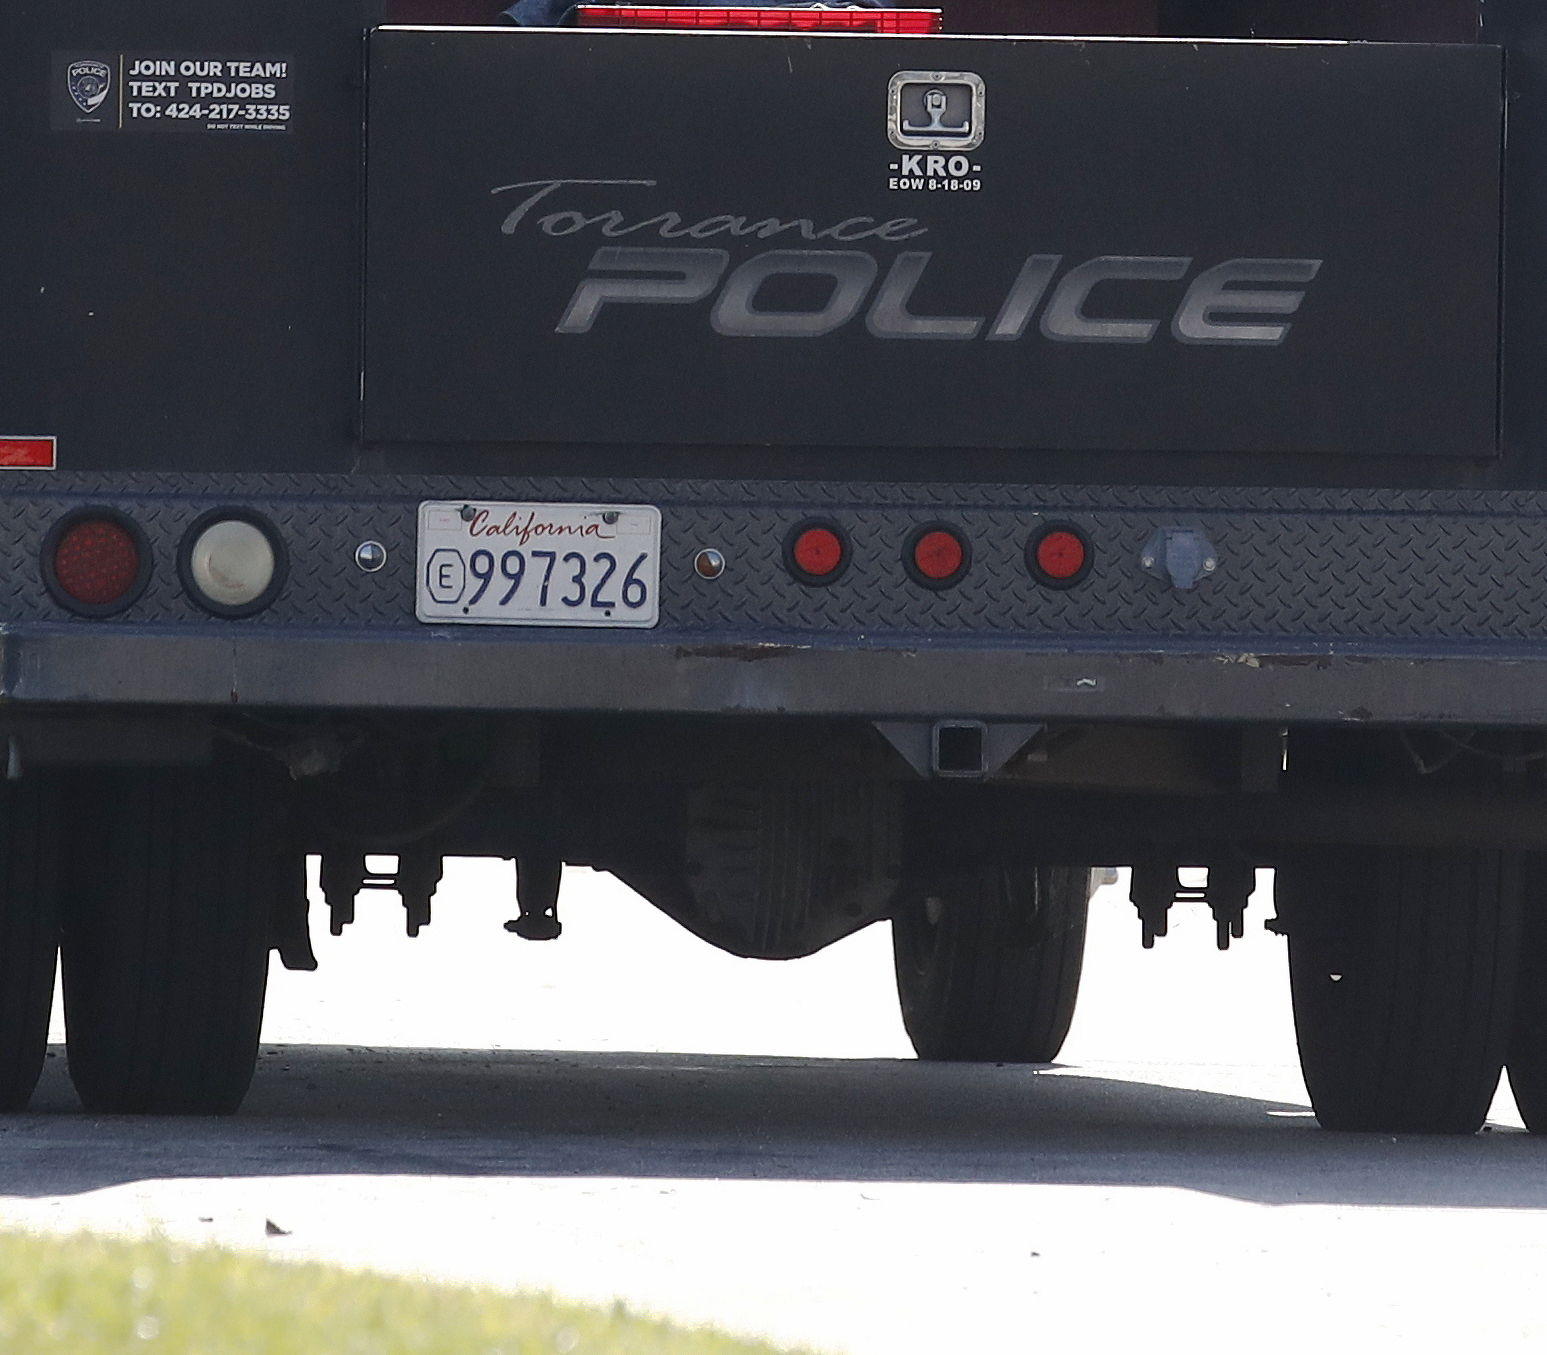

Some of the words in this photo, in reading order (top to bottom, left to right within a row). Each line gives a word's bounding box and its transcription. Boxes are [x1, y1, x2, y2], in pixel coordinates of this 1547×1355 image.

[71, 66, 108, 78] POLICE
[128, 59, 176, 77] JOIN
[179, 60, 223, 77] OUR
[226, 61, 288, 78] TEAM!
[128, 81, 180, 97] TEXT
[187, 82, 277, 99] TPDJOBS
[128, 102, 162, 119] TO:
[164, 102, 291, 121] 424-217-3335
[888, 177, 925, 190] EOW
[928, 178, 981, 191] 8-18-09
[490, 178, 929, 242] Torrance
[553, 246, 1324, 345] POLICE
[468, 509, 617, 546] California
[467, 547, 650, 609] 997326
